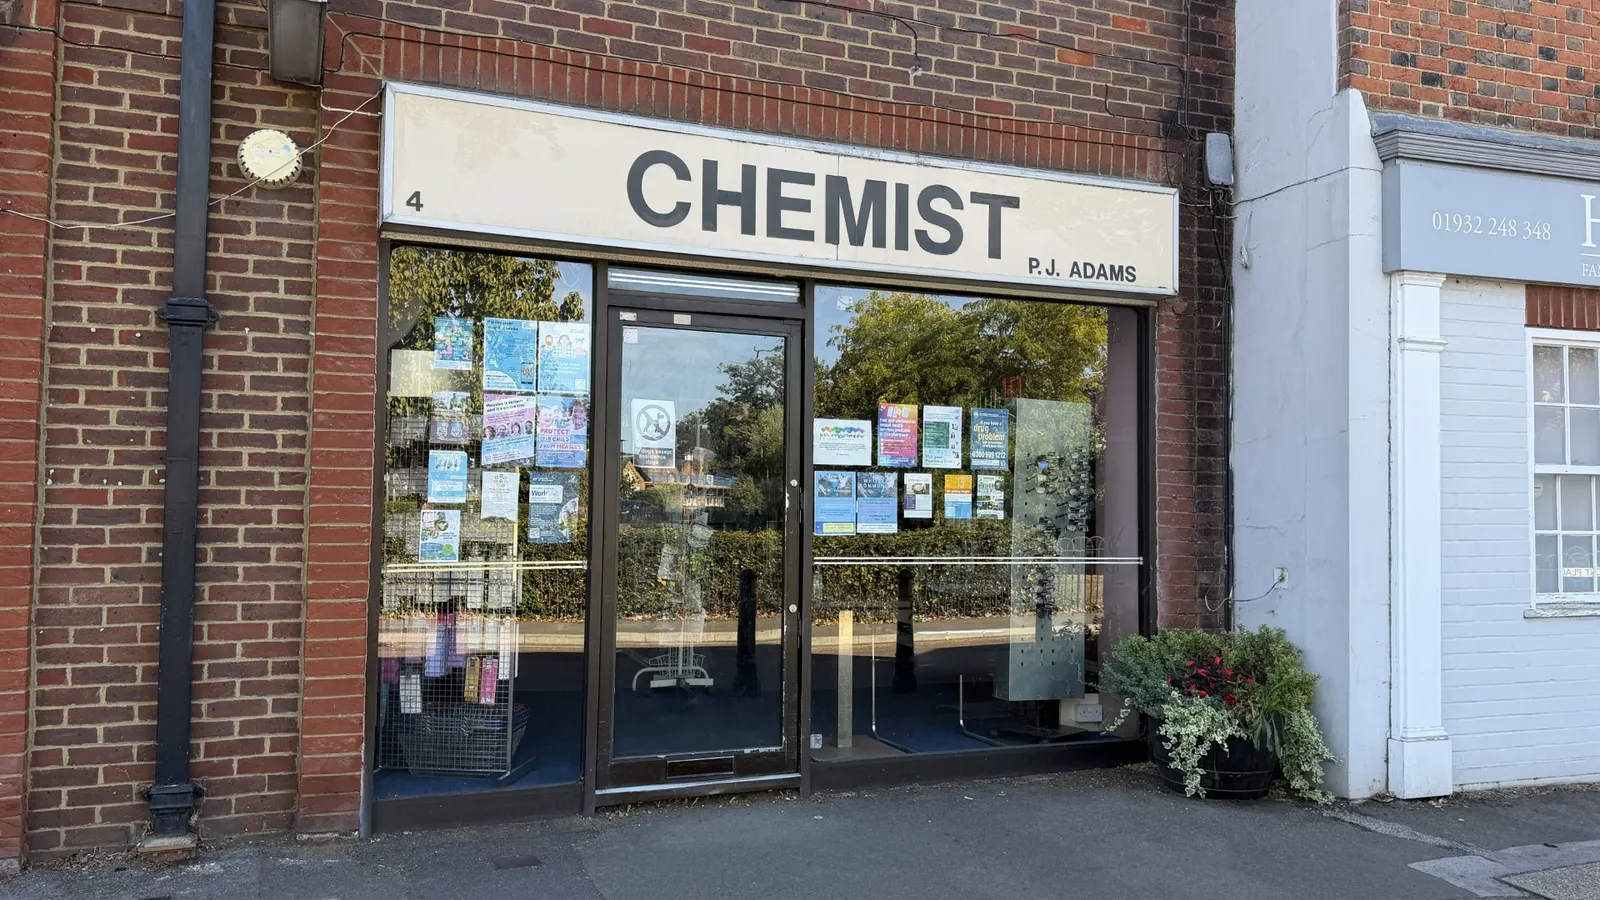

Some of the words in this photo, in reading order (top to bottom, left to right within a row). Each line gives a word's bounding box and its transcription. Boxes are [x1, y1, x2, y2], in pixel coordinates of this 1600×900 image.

[405, 190, 424, 212] 4
[626, 149, 1021, 260] CHEMIST
[1432, 211, 1483, 234] 01932
[1488, 217, 1518, 237] 248
[1523, 220, 1551, 241] 348
[1069, 261, 1137, 283] ADAMS
[1582, 263, 1600, 278] FA
[973, 424, 990, 434] drug
